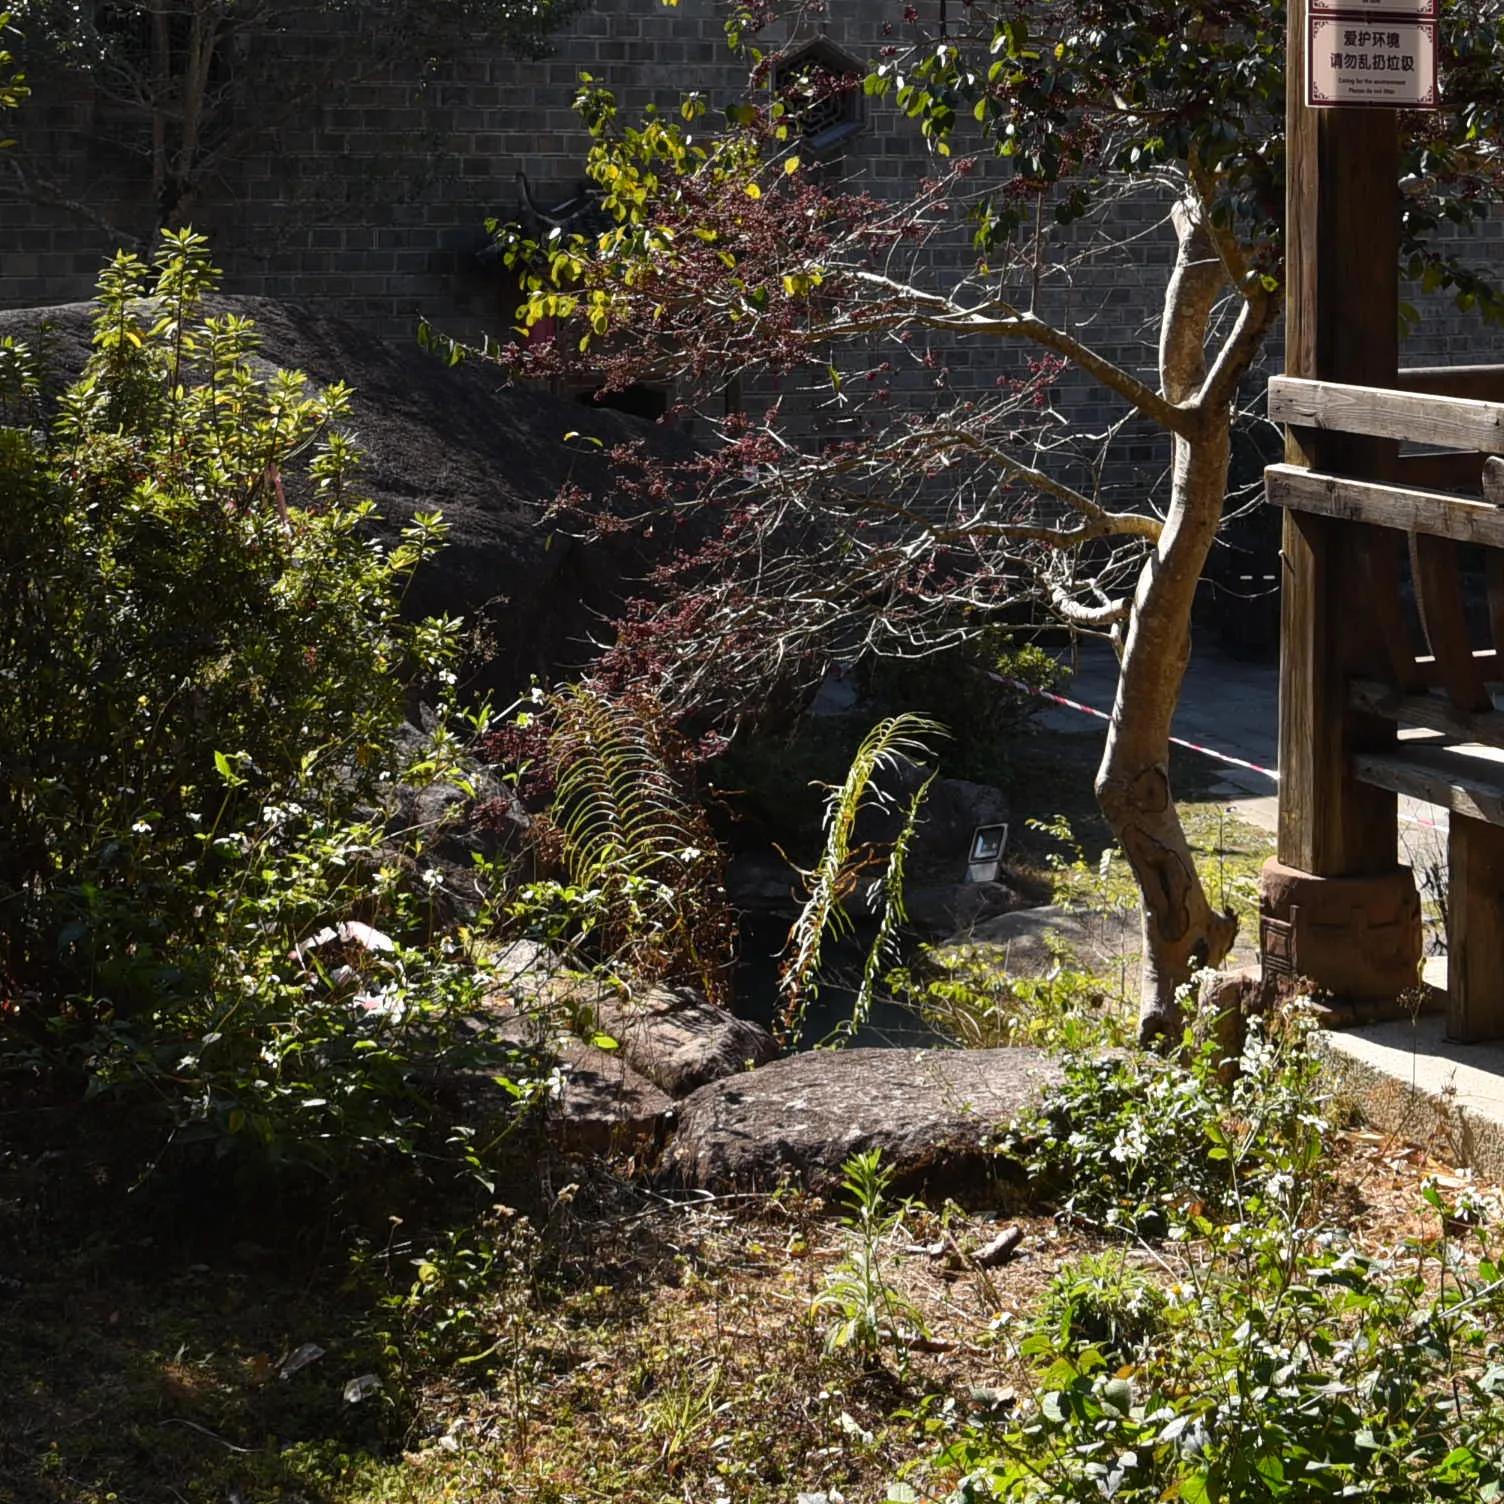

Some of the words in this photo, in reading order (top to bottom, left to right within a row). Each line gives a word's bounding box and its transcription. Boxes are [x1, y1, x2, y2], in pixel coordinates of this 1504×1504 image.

[1344, 30, 1400, 48] 爱护环境
[1331, 52, 1414, 72] 请勿乱扔垃圾
